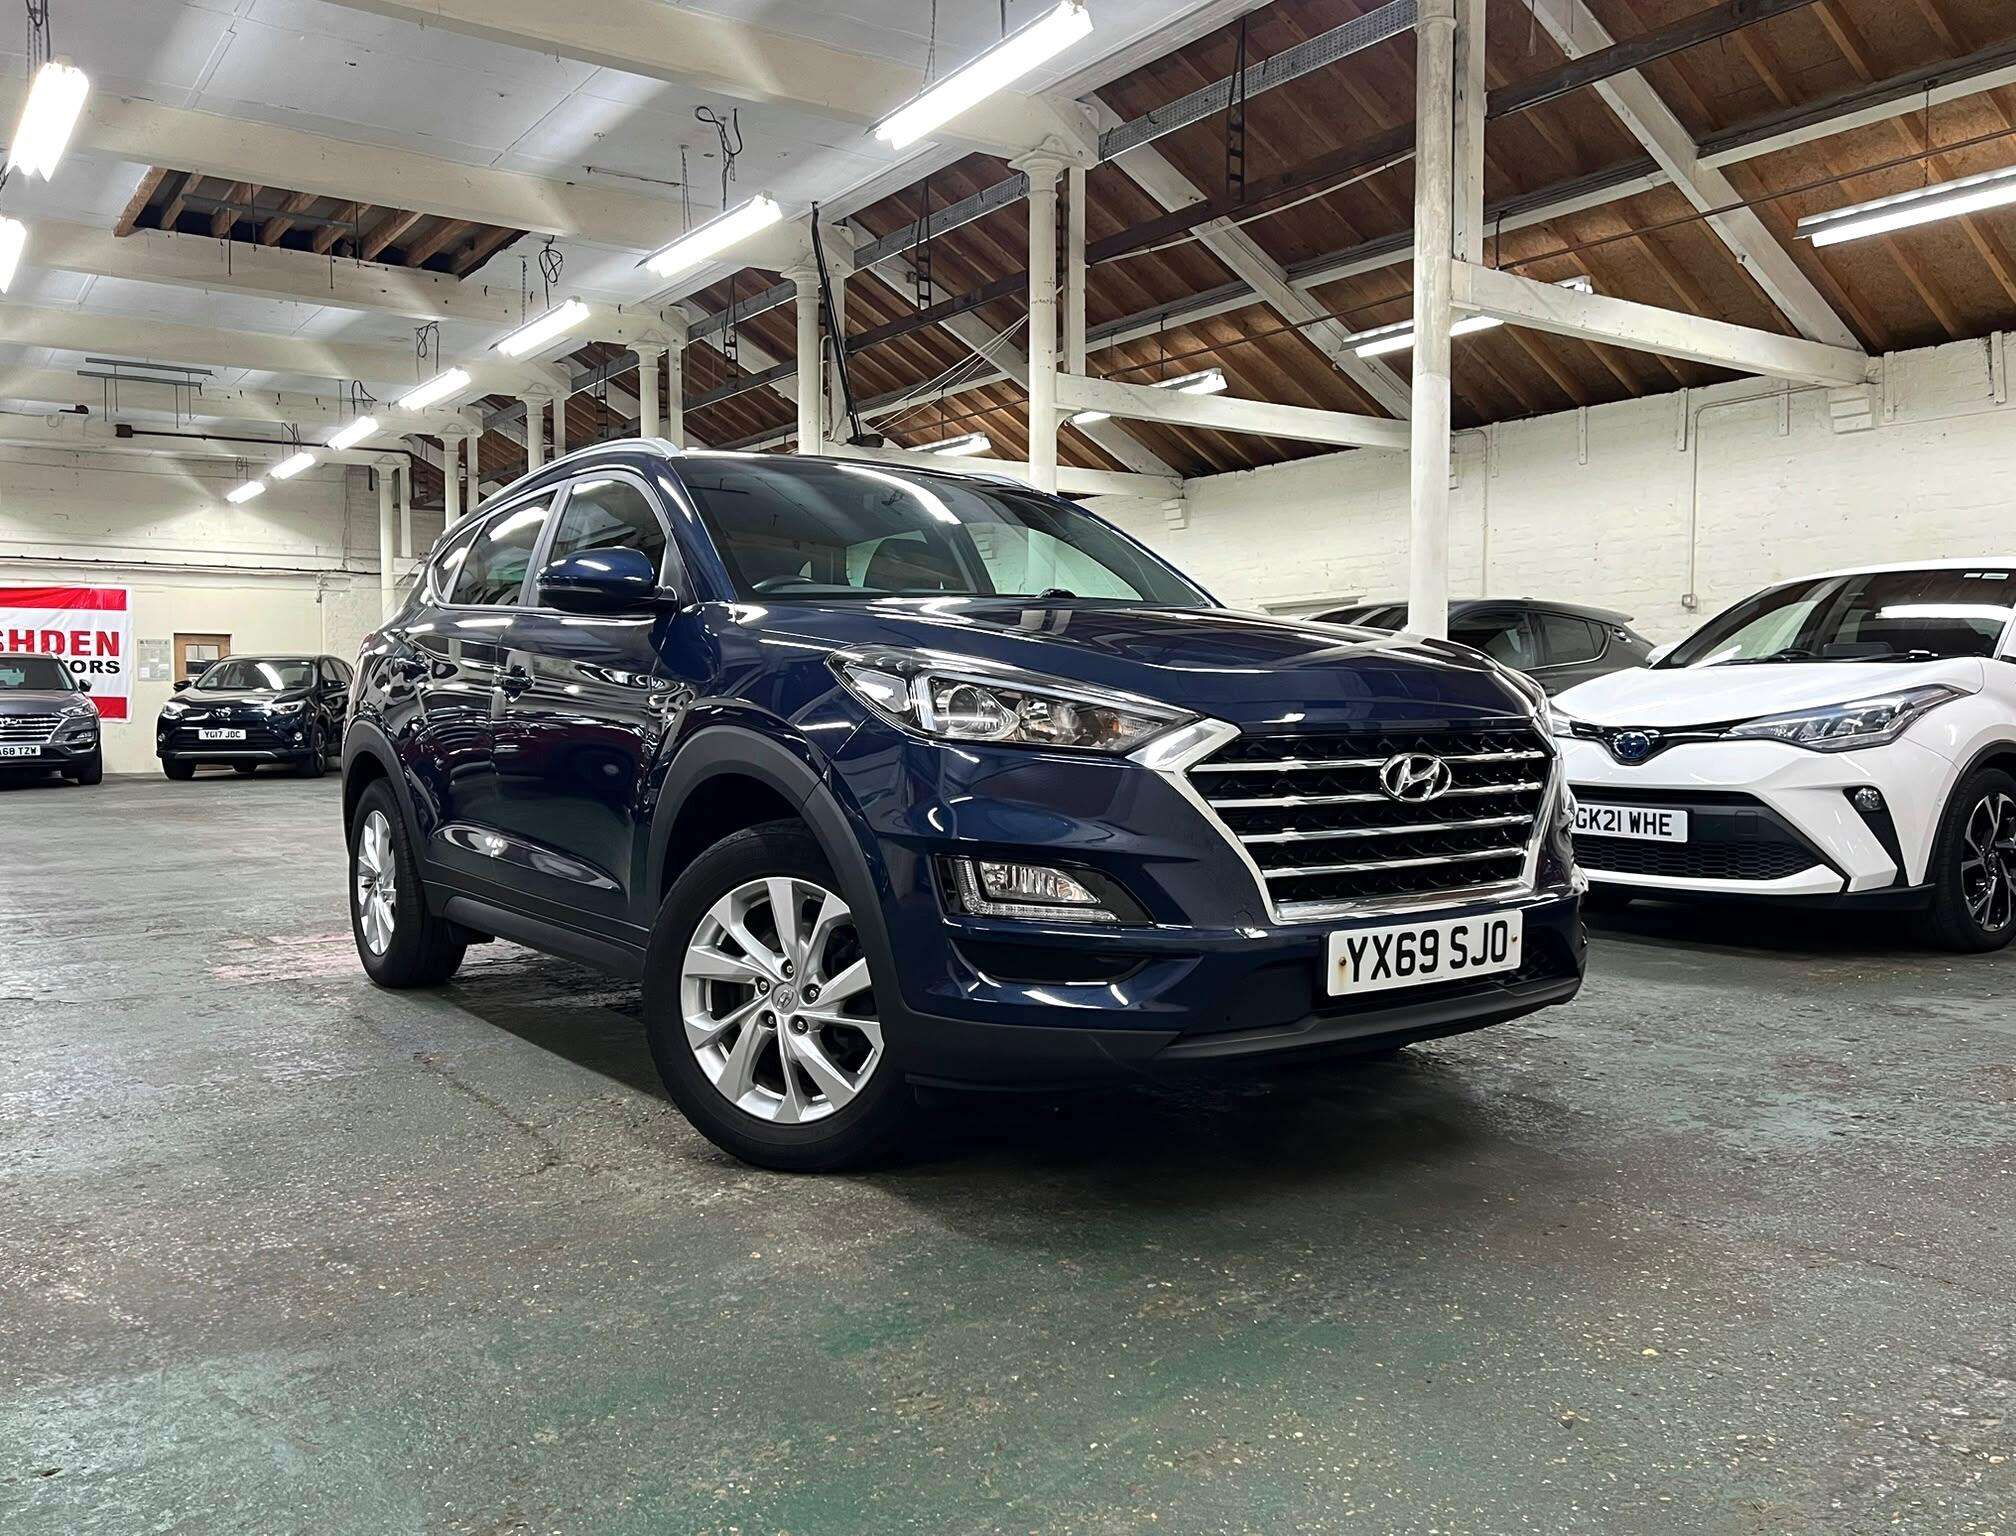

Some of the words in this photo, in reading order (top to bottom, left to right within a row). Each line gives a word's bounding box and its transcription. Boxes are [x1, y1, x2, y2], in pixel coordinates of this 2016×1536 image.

[0, 629, 119, 656] HDEN
[63, 660, 120, 674] ORS
[1575, 808, 1622, 832] GK21
[1629, 811, 1672, 836] WHE
[1346, 929, 1440, 982] YX69
[1449, 920, 1508, 970] SJO
